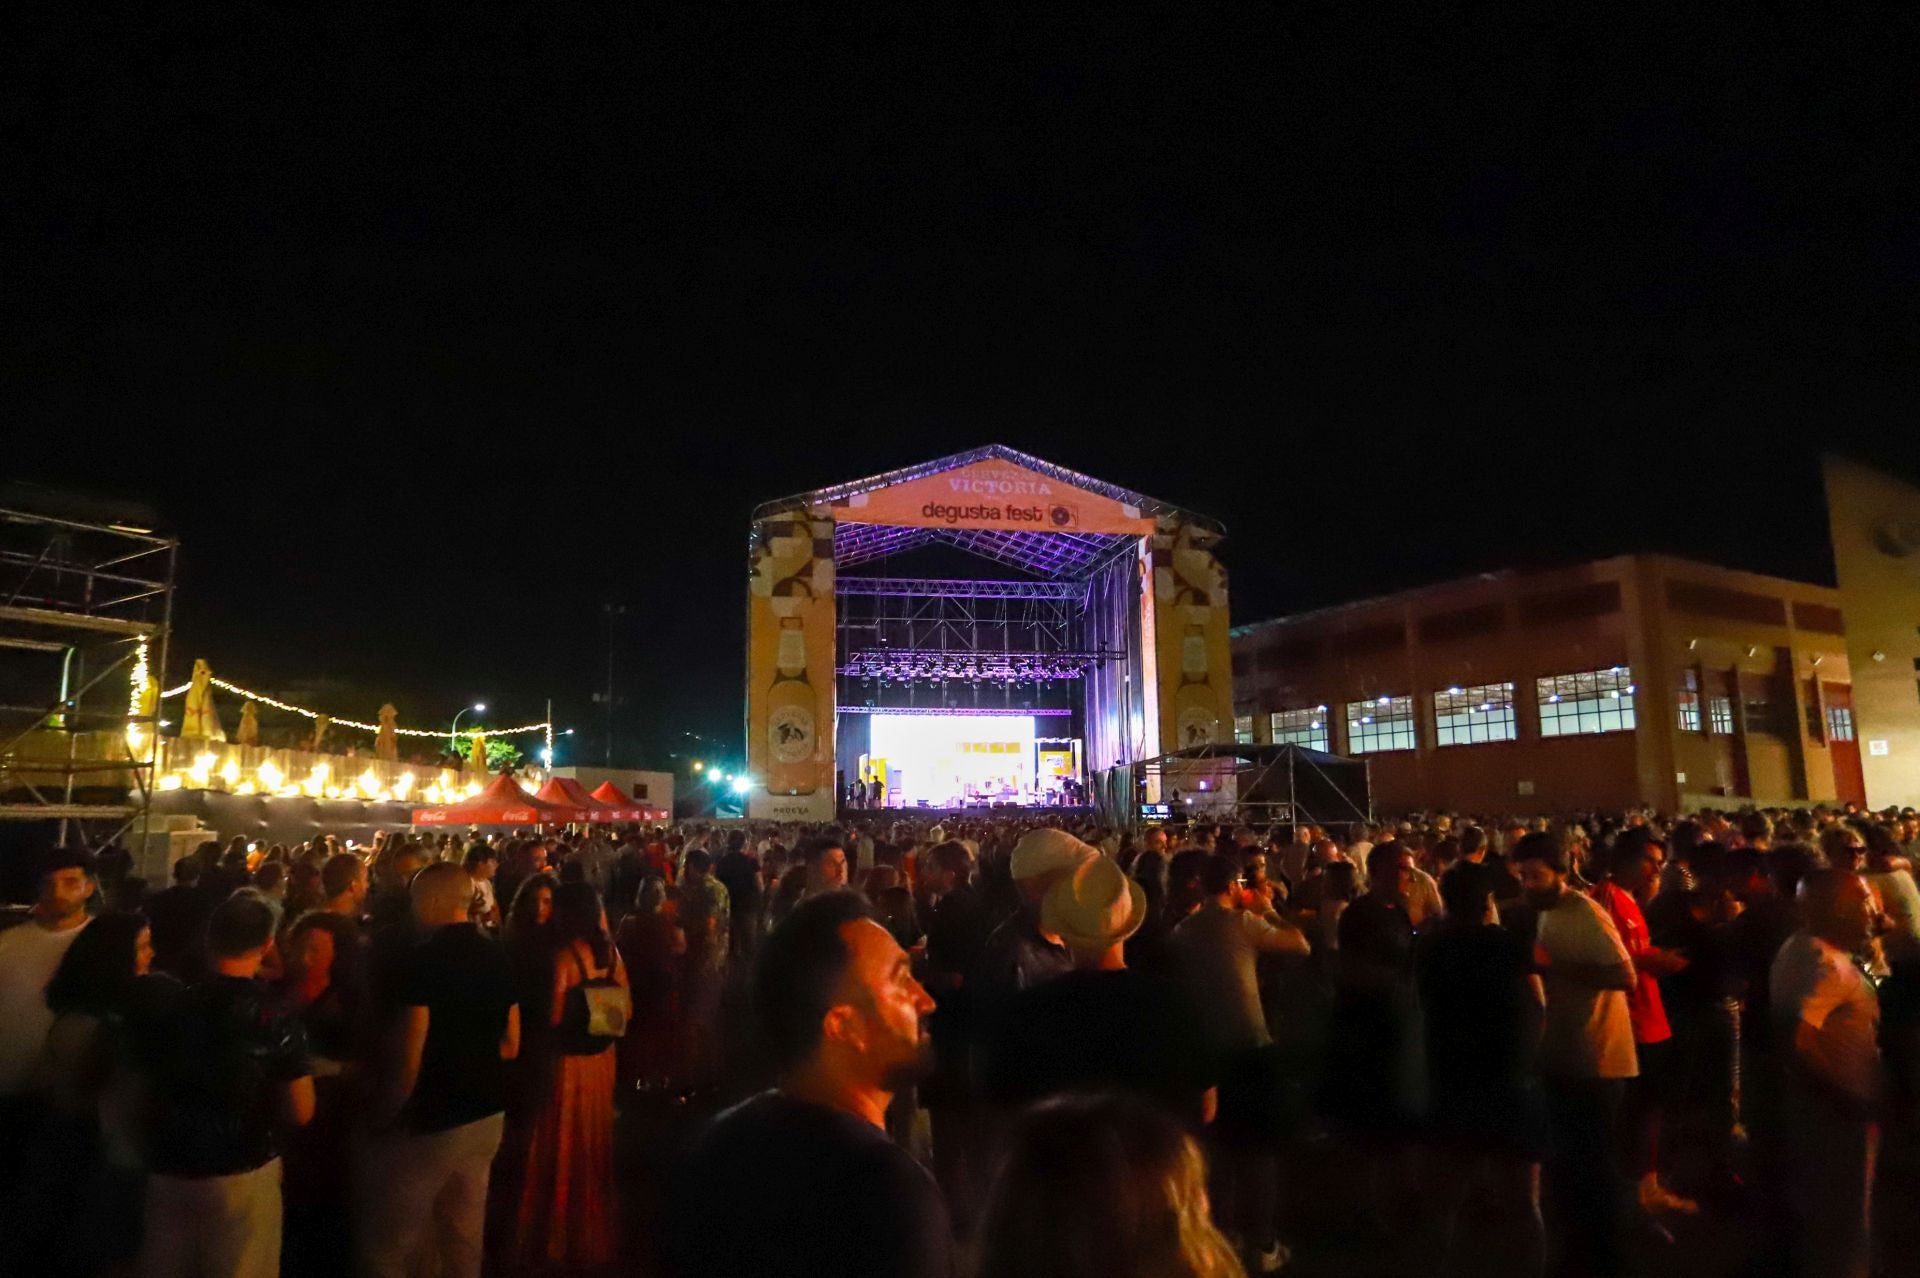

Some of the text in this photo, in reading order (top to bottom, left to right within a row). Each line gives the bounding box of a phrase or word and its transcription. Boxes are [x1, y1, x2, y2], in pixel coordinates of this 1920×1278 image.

[949, 477, 1053, 496] VICTORIA
[922, 501, 1043, 524] degusta fest
